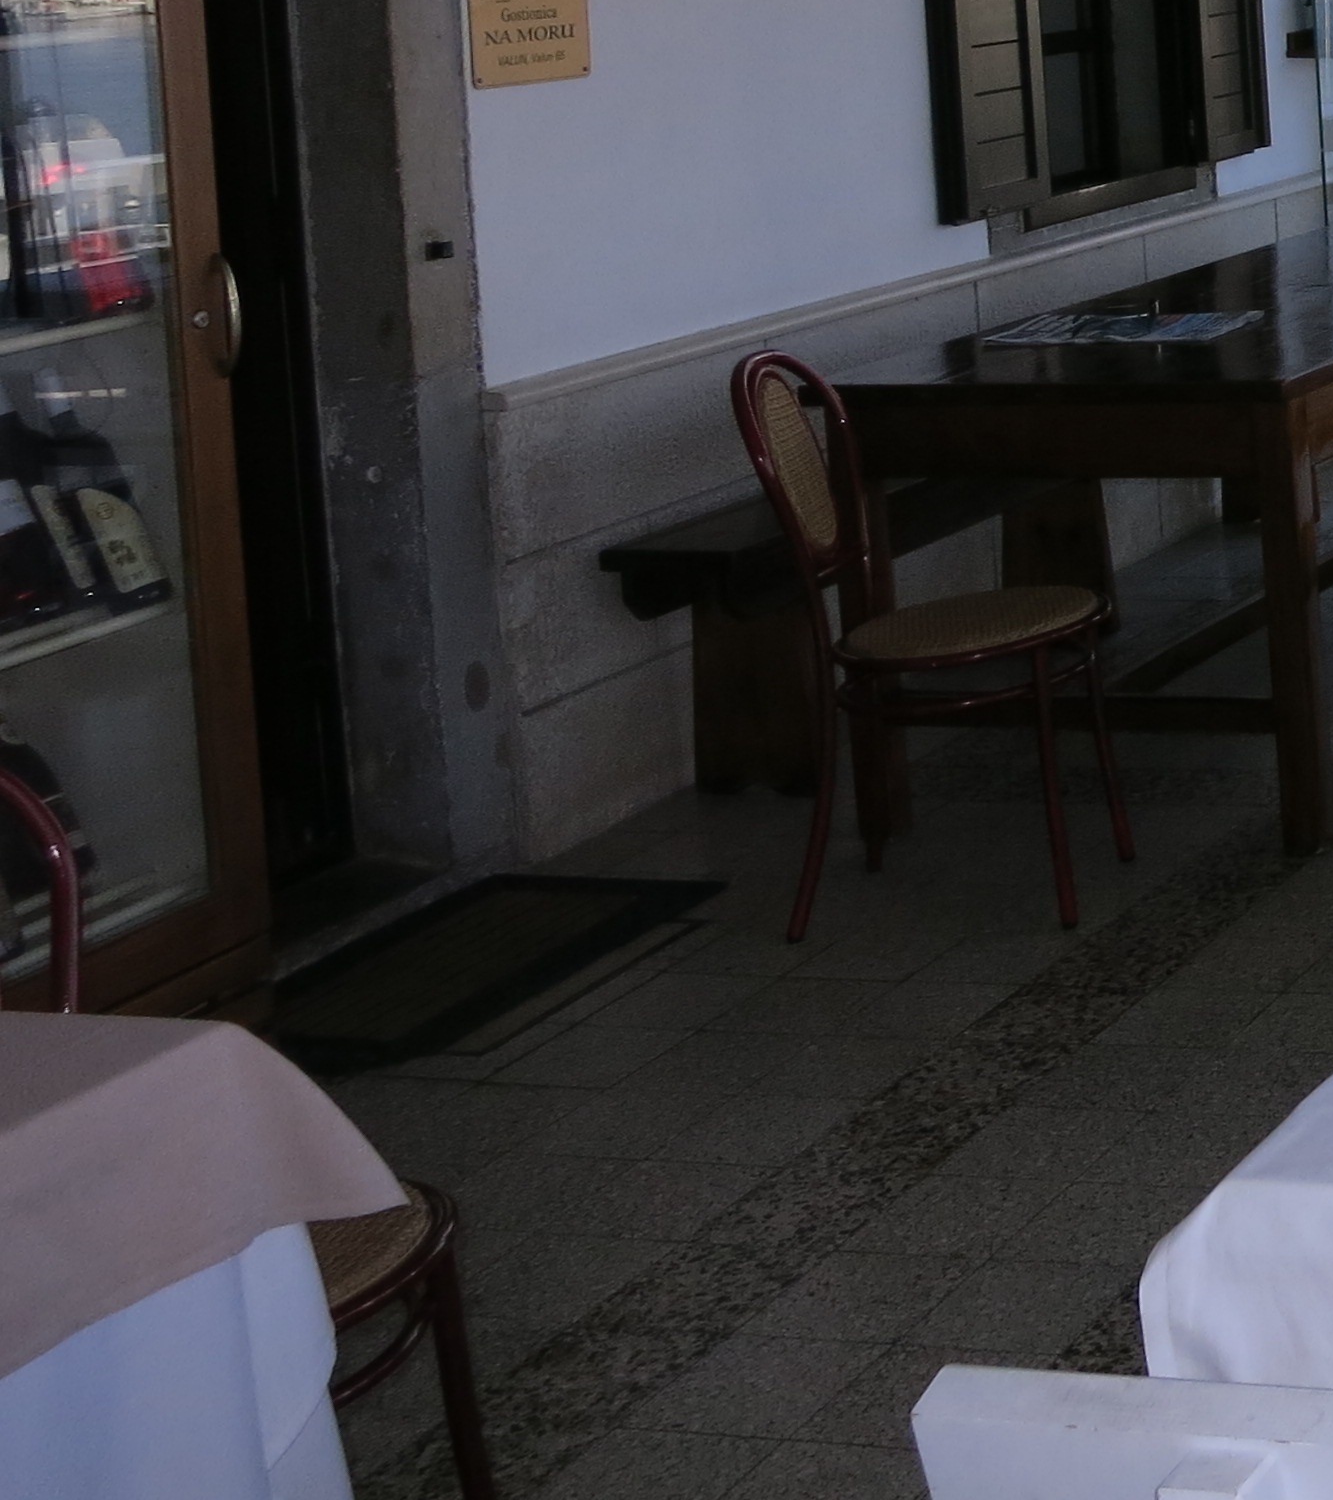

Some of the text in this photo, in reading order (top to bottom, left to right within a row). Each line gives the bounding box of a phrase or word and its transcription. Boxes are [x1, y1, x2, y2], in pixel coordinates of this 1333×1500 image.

[500, 4, 558, 23] Gostionica
[484, 23, 575, 46] NA MORU
